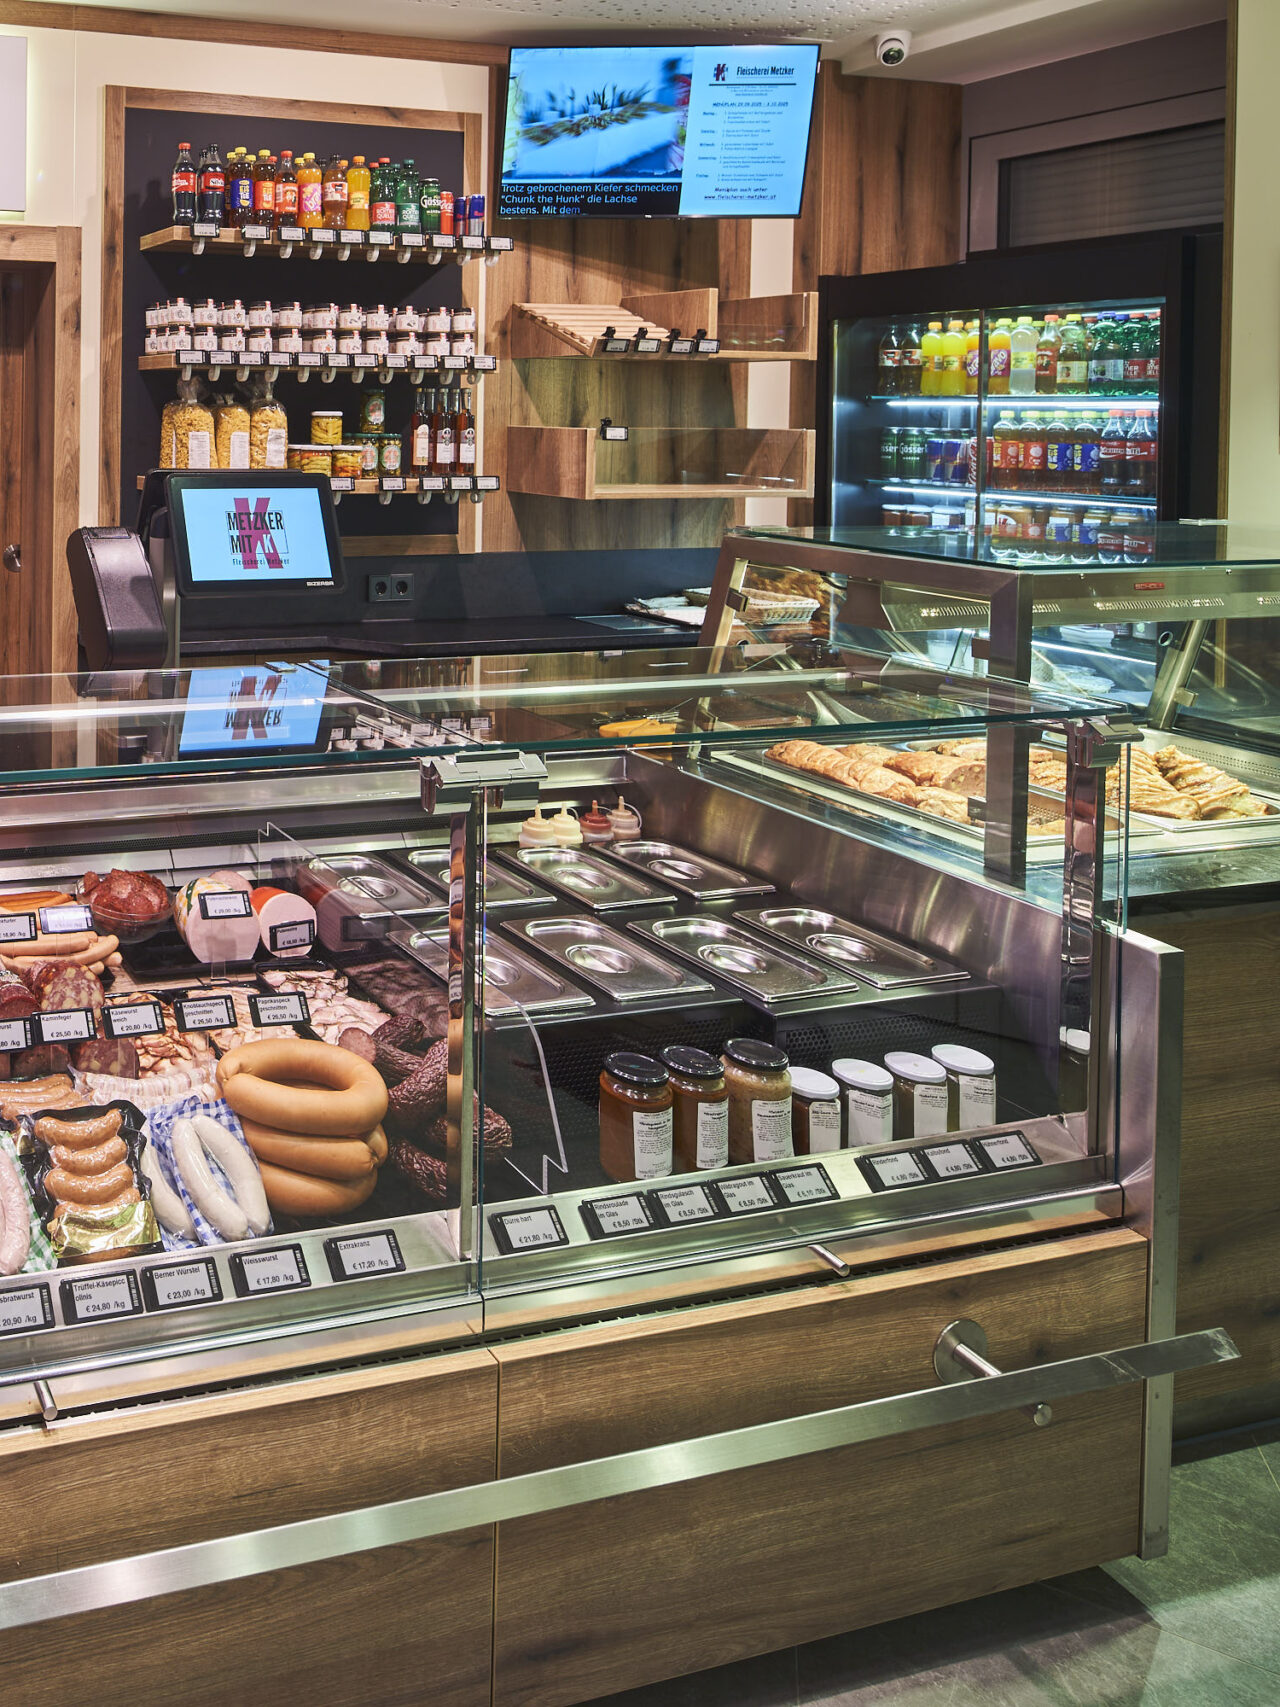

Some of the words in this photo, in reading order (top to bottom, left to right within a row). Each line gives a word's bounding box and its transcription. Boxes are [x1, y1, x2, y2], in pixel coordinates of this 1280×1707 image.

[736, 66, 769, 76] Fleischerei
[770, 66, 794, 75] Metzker
[501, 183, 524, 193] Trotz
[527, 183, 592, 194] gebrochenem
[594, 183, 621, 193] Kiefer
[624, 183, 678, 193] schmecken
[537, 194, 553, 204] the
[587, 194, 601, 204] die
[604, 194, 638, 204] Lachse
[500, 205, 539, 215] bestens.
[542, 205, 557, 215] Mit
[559, 205, 581, 215] dem
[227, 511, 284, 531] METZKER
[230, 534, 252, 554] MIT
[659, 1189, 695, 1201] Rindsgulasch
[593, 1200, 629, 1211] Rindsroulade
[670, 1200, 684, 1208] Glas
[605, 1210, 619, 1218] Glas
[683, 1209, 696, 1217] 8,50
[697, 1206, 709, 1215] /Stk
[504, 1217, 519, 1226] Dürre
[520, 1215, 532, 1223] hart
[632, 1217, 644, 1226] /Stk
[519, 1235, 524, 1243] €
[524, 1234, 541, 1243] 21,80
[542, 1233, 553, 1241] /kg
[338, 1240, 371, 1250] Extrakranz
[243, 1254, 279, 1265] Weisswurst
[358, 1260, 376, 1270] 17,20
[377, 1259, 389, 1269] /kg
[154, 1270, 175, 1280] Berner
[176, 1266, 200, 1277] Würstel
[73, 1278, 126, 1292] Trüffel-Käsepicc
[263, 1275, 280, 1285] 17,80
[282, 1274, 295, 1283] /kg
[167, 1292, 172, 1300] €
[172, 1290, 192, 1300] 23,00
[194, 1288, 206, 1298] /kg
[86, 1305, 91, 1313] €
[91, 1302, 111, 1313] 24,80
[113, 1301, 126, 1311] /kg
[2, 1317, 22, 1327] 20,90
[24, 1314, 37, 1324] /kg
